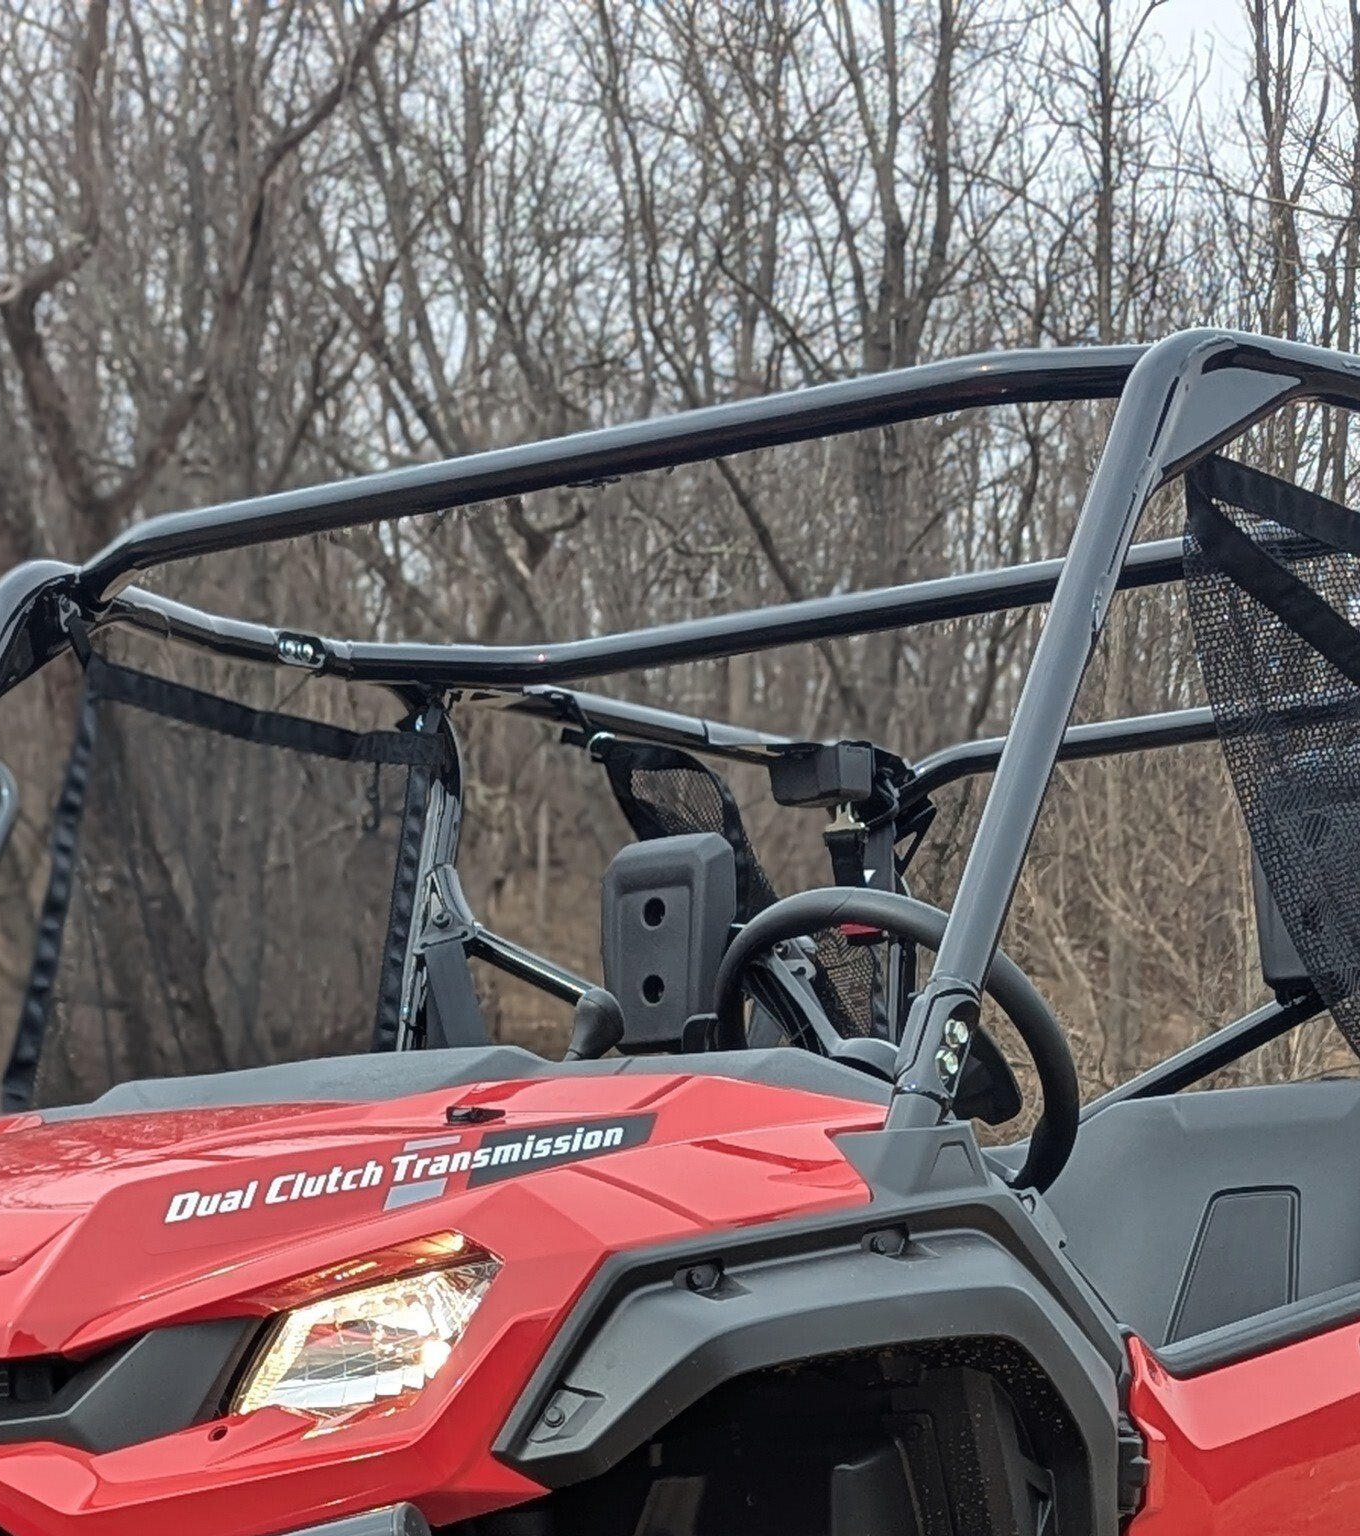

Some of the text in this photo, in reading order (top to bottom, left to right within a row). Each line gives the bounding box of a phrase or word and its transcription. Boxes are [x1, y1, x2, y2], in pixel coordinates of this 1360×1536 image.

[164, 1126, 624, 1223] Dual Clutch Transmission
